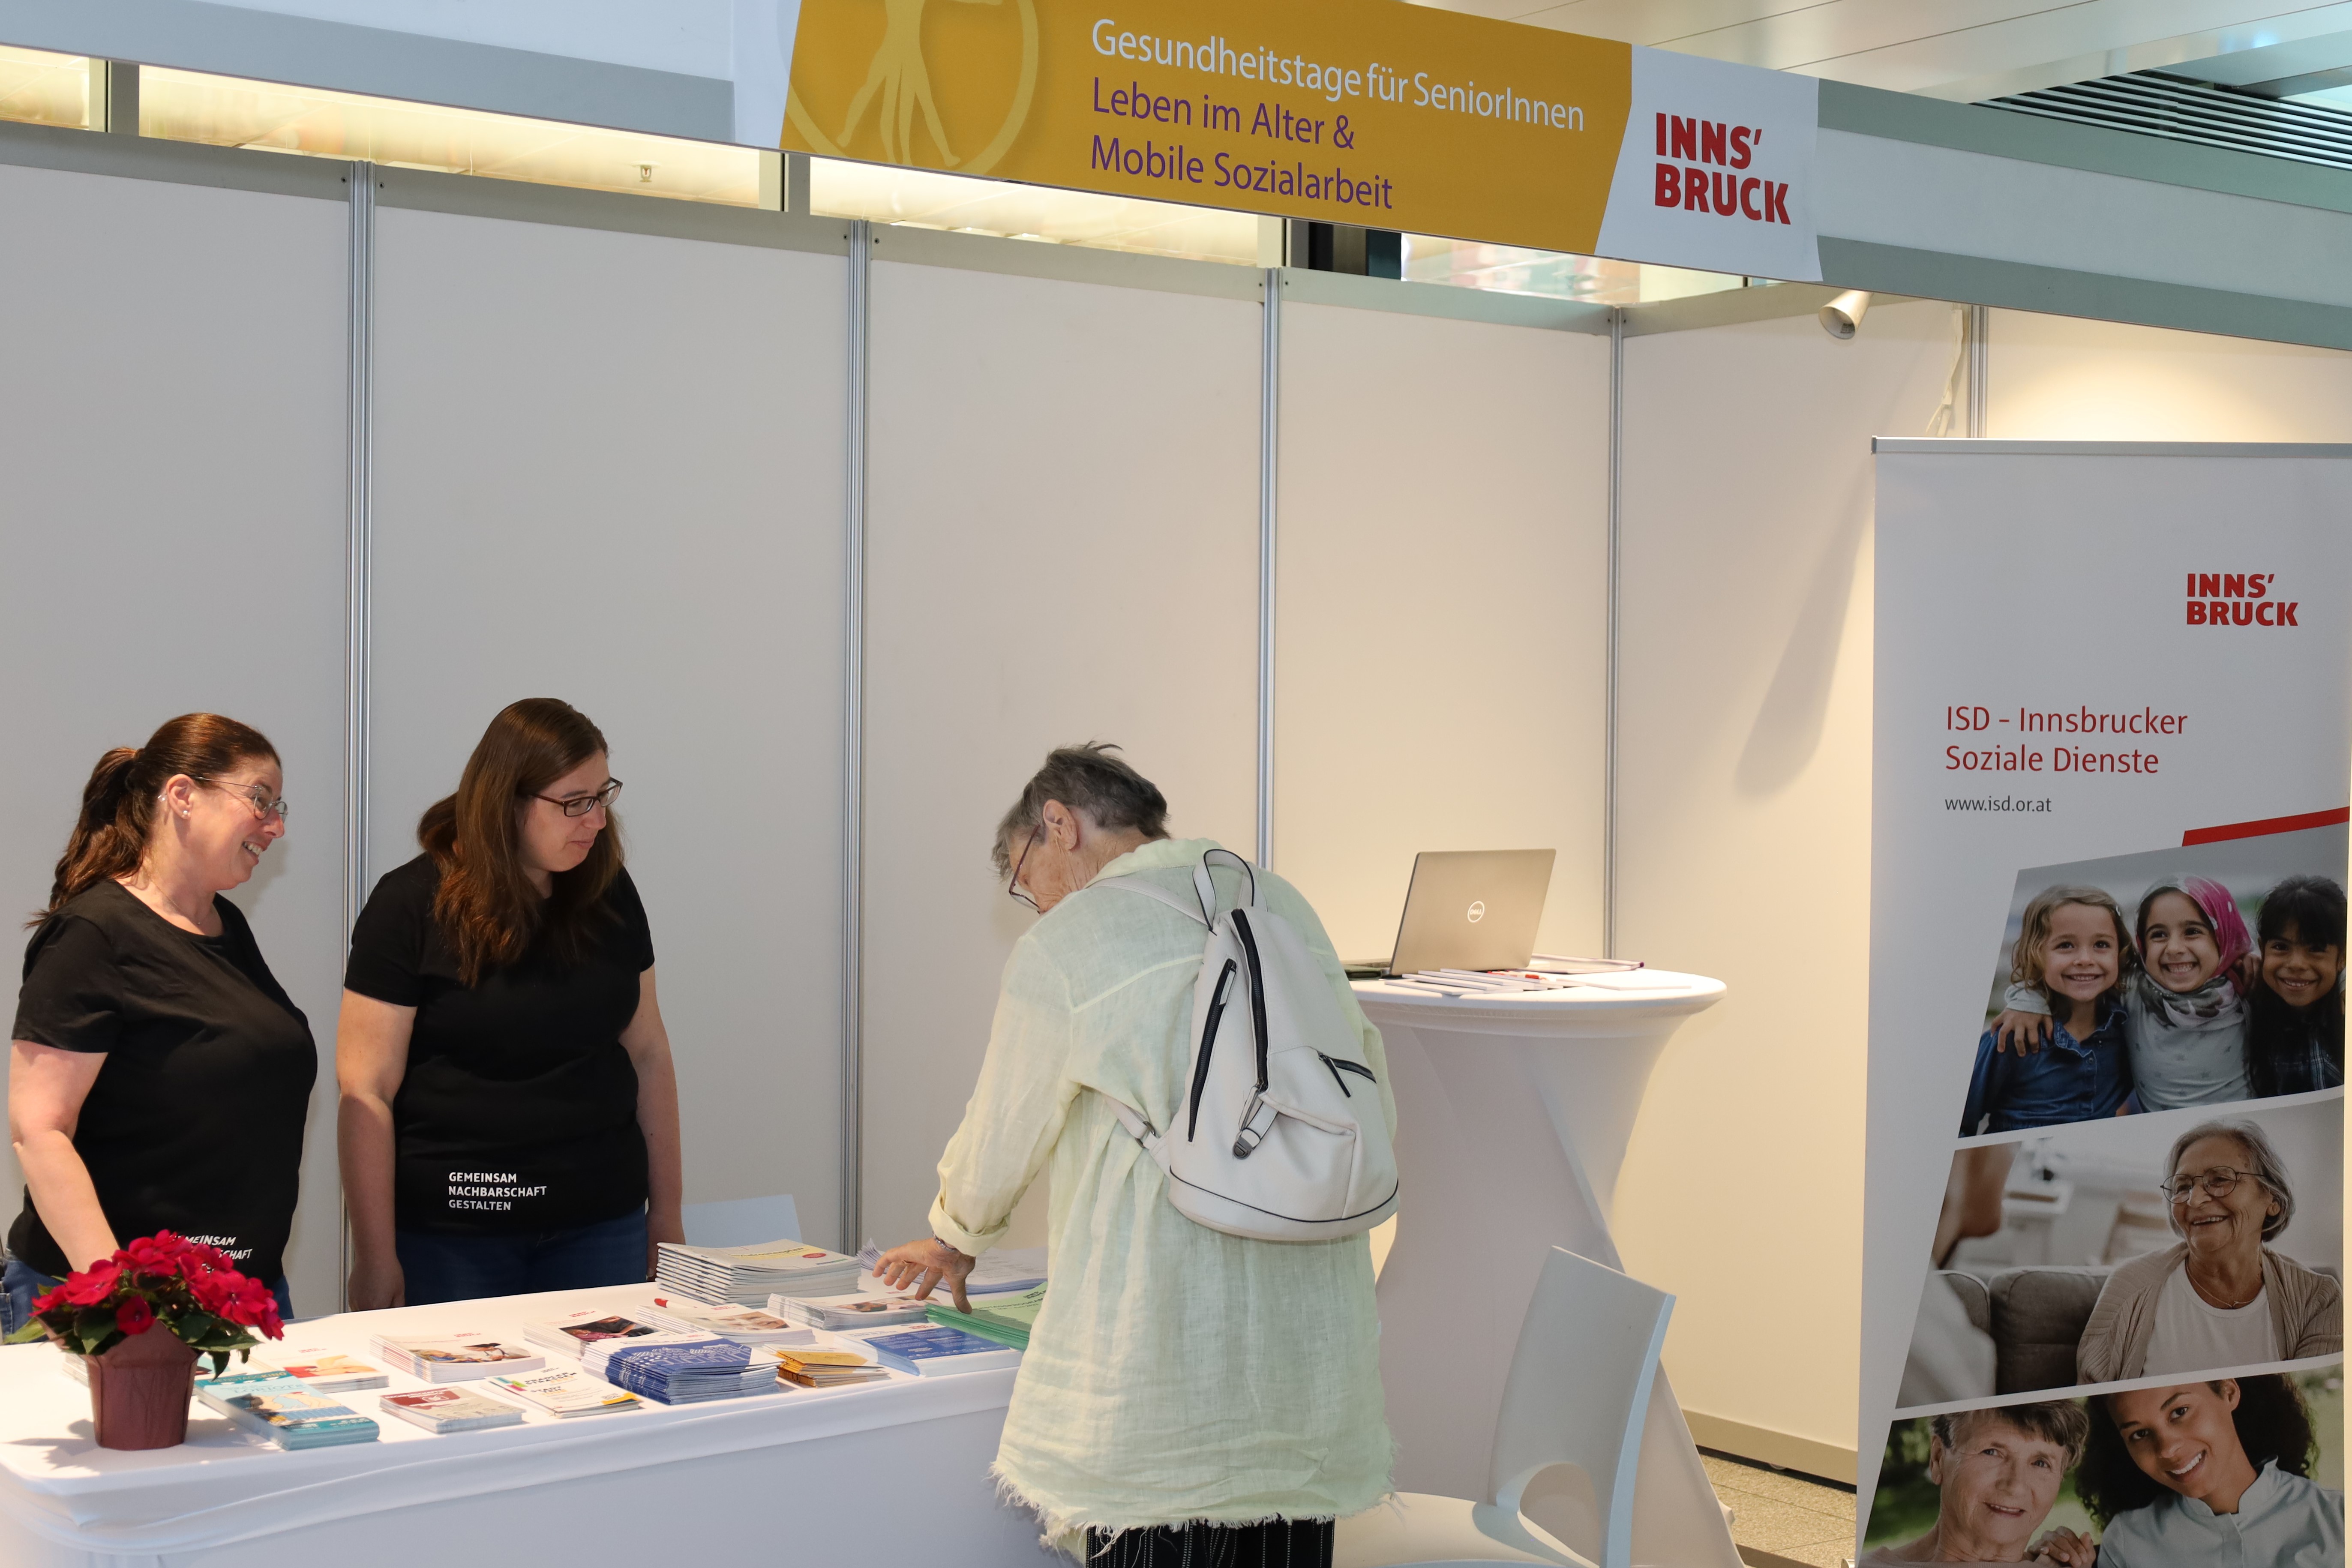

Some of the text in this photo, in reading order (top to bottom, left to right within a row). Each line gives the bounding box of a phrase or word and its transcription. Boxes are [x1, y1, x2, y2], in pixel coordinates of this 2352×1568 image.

[1092, 18, 1584, 131] Gesundheitstage für SeniorInnen
[1095, 77, 1354, 149] Leben im Alter &
[1092, 135, 1393, 209] Mobile Sozialarbeit
[1655, 163, 1790, 225] BRUCK
[2187, 600, 2298, 627] BRUCK
[1947, 705, 1991, 731] ISD
[2020, 705, 2188, 735] Innsbrucker
[1945, 744, 2160, 774] Soziale Dienste
[1944, 795, 2052, 812] www.isd.or.at
[448, 1172, 517, 1183] GEMEINSAM
[448, 1185, 547, 1197] NACHBARSCHAFT
[448, 1199, 512, 1211] GESTALTEN
